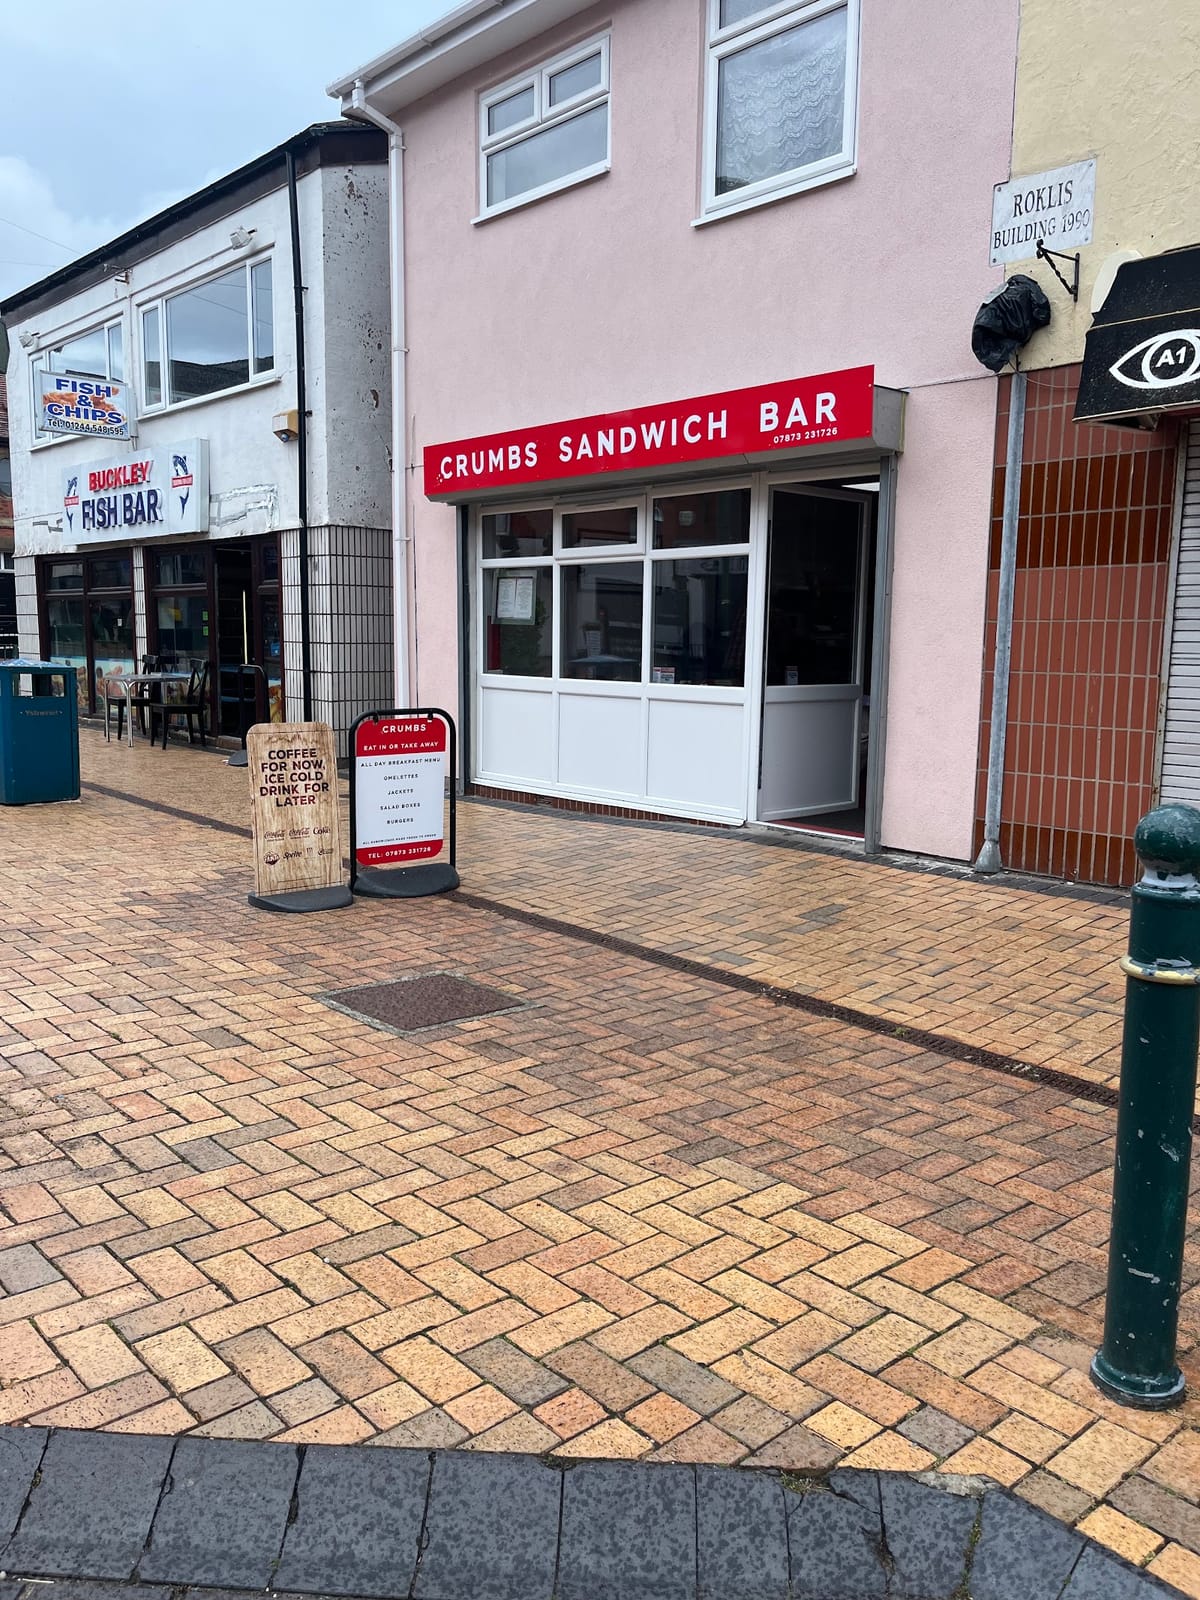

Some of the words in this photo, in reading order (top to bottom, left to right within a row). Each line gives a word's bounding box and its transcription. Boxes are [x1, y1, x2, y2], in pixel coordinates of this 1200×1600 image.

[1012, 180, 1073, 218] ROKLIS
[993, 217, 1056, 249] BUILDING
[1062, 208, 1091, 233] 1990
[1155, 345, 1187, 368] A1
[56, 378, 112, 398] FISH
[77, 394, 93, 408] &
[47, 403, 122, 425] CHIPS
[440, 442, 538, 480] CRUMBS
[558, 409, 728, 462] SANDWICH
[759, 391, 838, 432] BAR
[773, 432, 802, 444] 07873
[804, 427, 838, 440] 231726
[89, 461, 150, 491] BUCKLEY
[82, 496, 118, 529] FISH
[123, 489, 159, 524] BAR
[382, 723, 427, 734] CRUMBS
[268, 748, 318, 760] COFFEE
[261, 761, 288, 773] FOR
[264, 773, 285, 784] ICE
[289, 771, 324, 782] COLD
[383, 773, 419, 781] OMELETTES
[260, 784, 300, 797] DRINK
[304, 782, 329, 793] FOR
[387, 788, 414, 796] JACKETS
[275, 795, 316, 808] LATER
[386, 817, 414, 825] BURGERS
